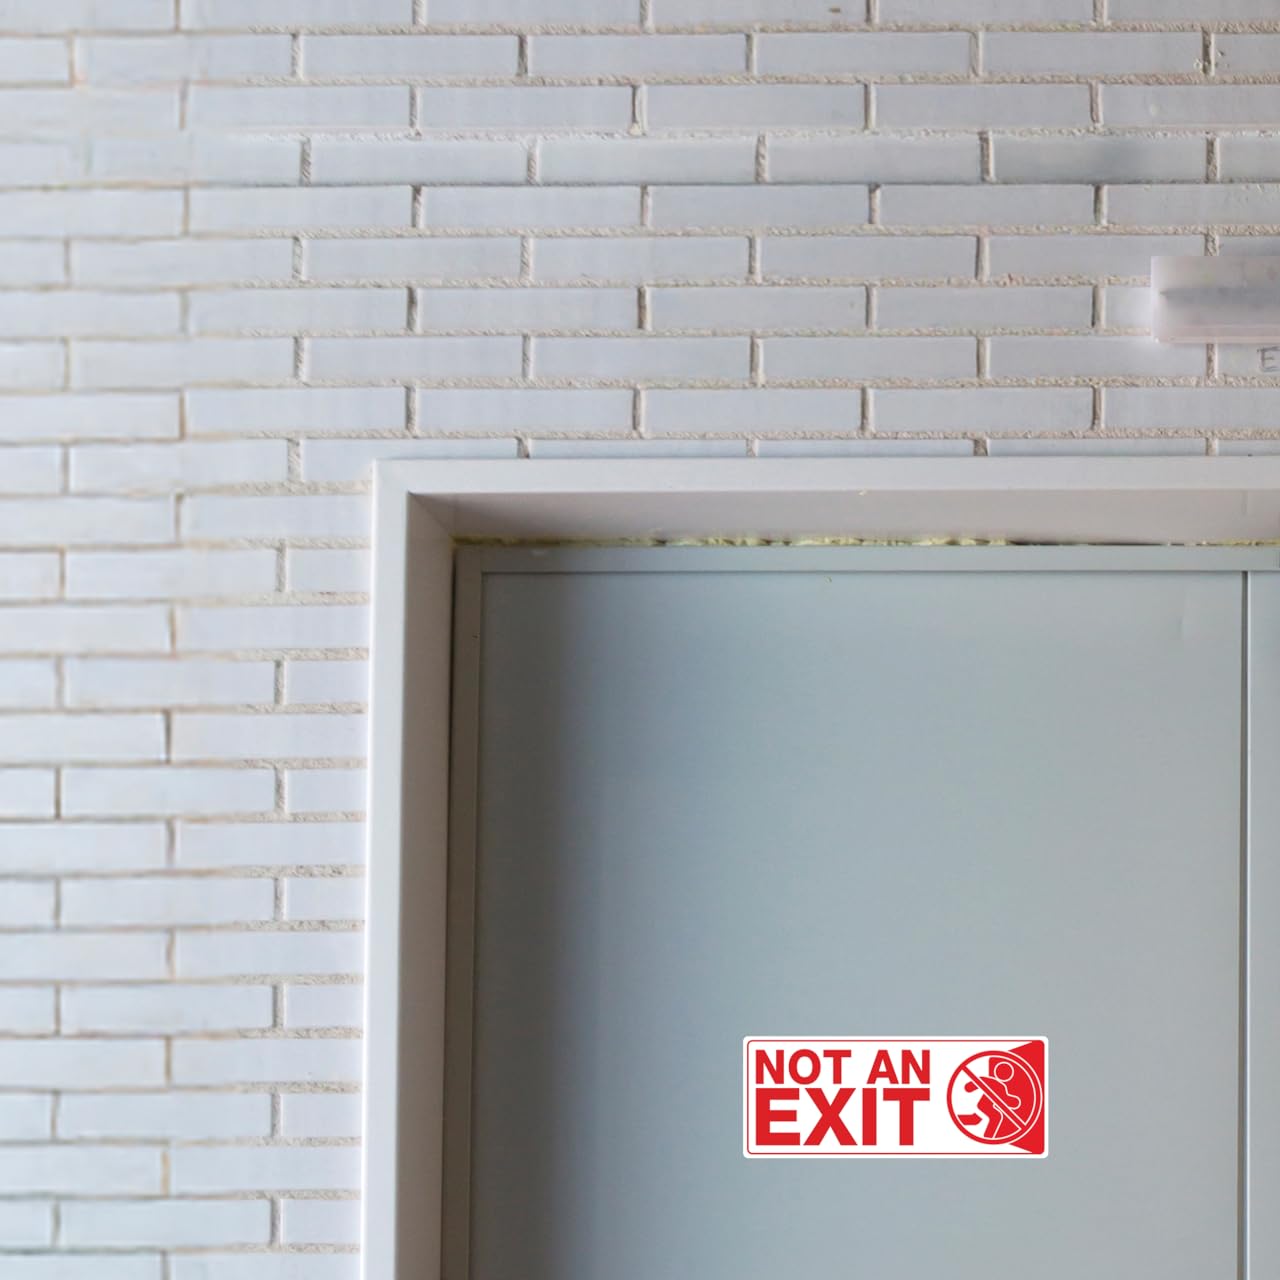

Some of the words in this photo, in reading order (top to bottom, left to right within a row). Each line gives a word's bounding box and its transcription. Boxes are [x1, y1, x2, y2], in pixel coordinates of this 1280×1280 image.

[755, 1049, 852, 1085] NOT
[866, 1049, 931, 1085] AN
[755, 1087, 931, 1146] EXIT
